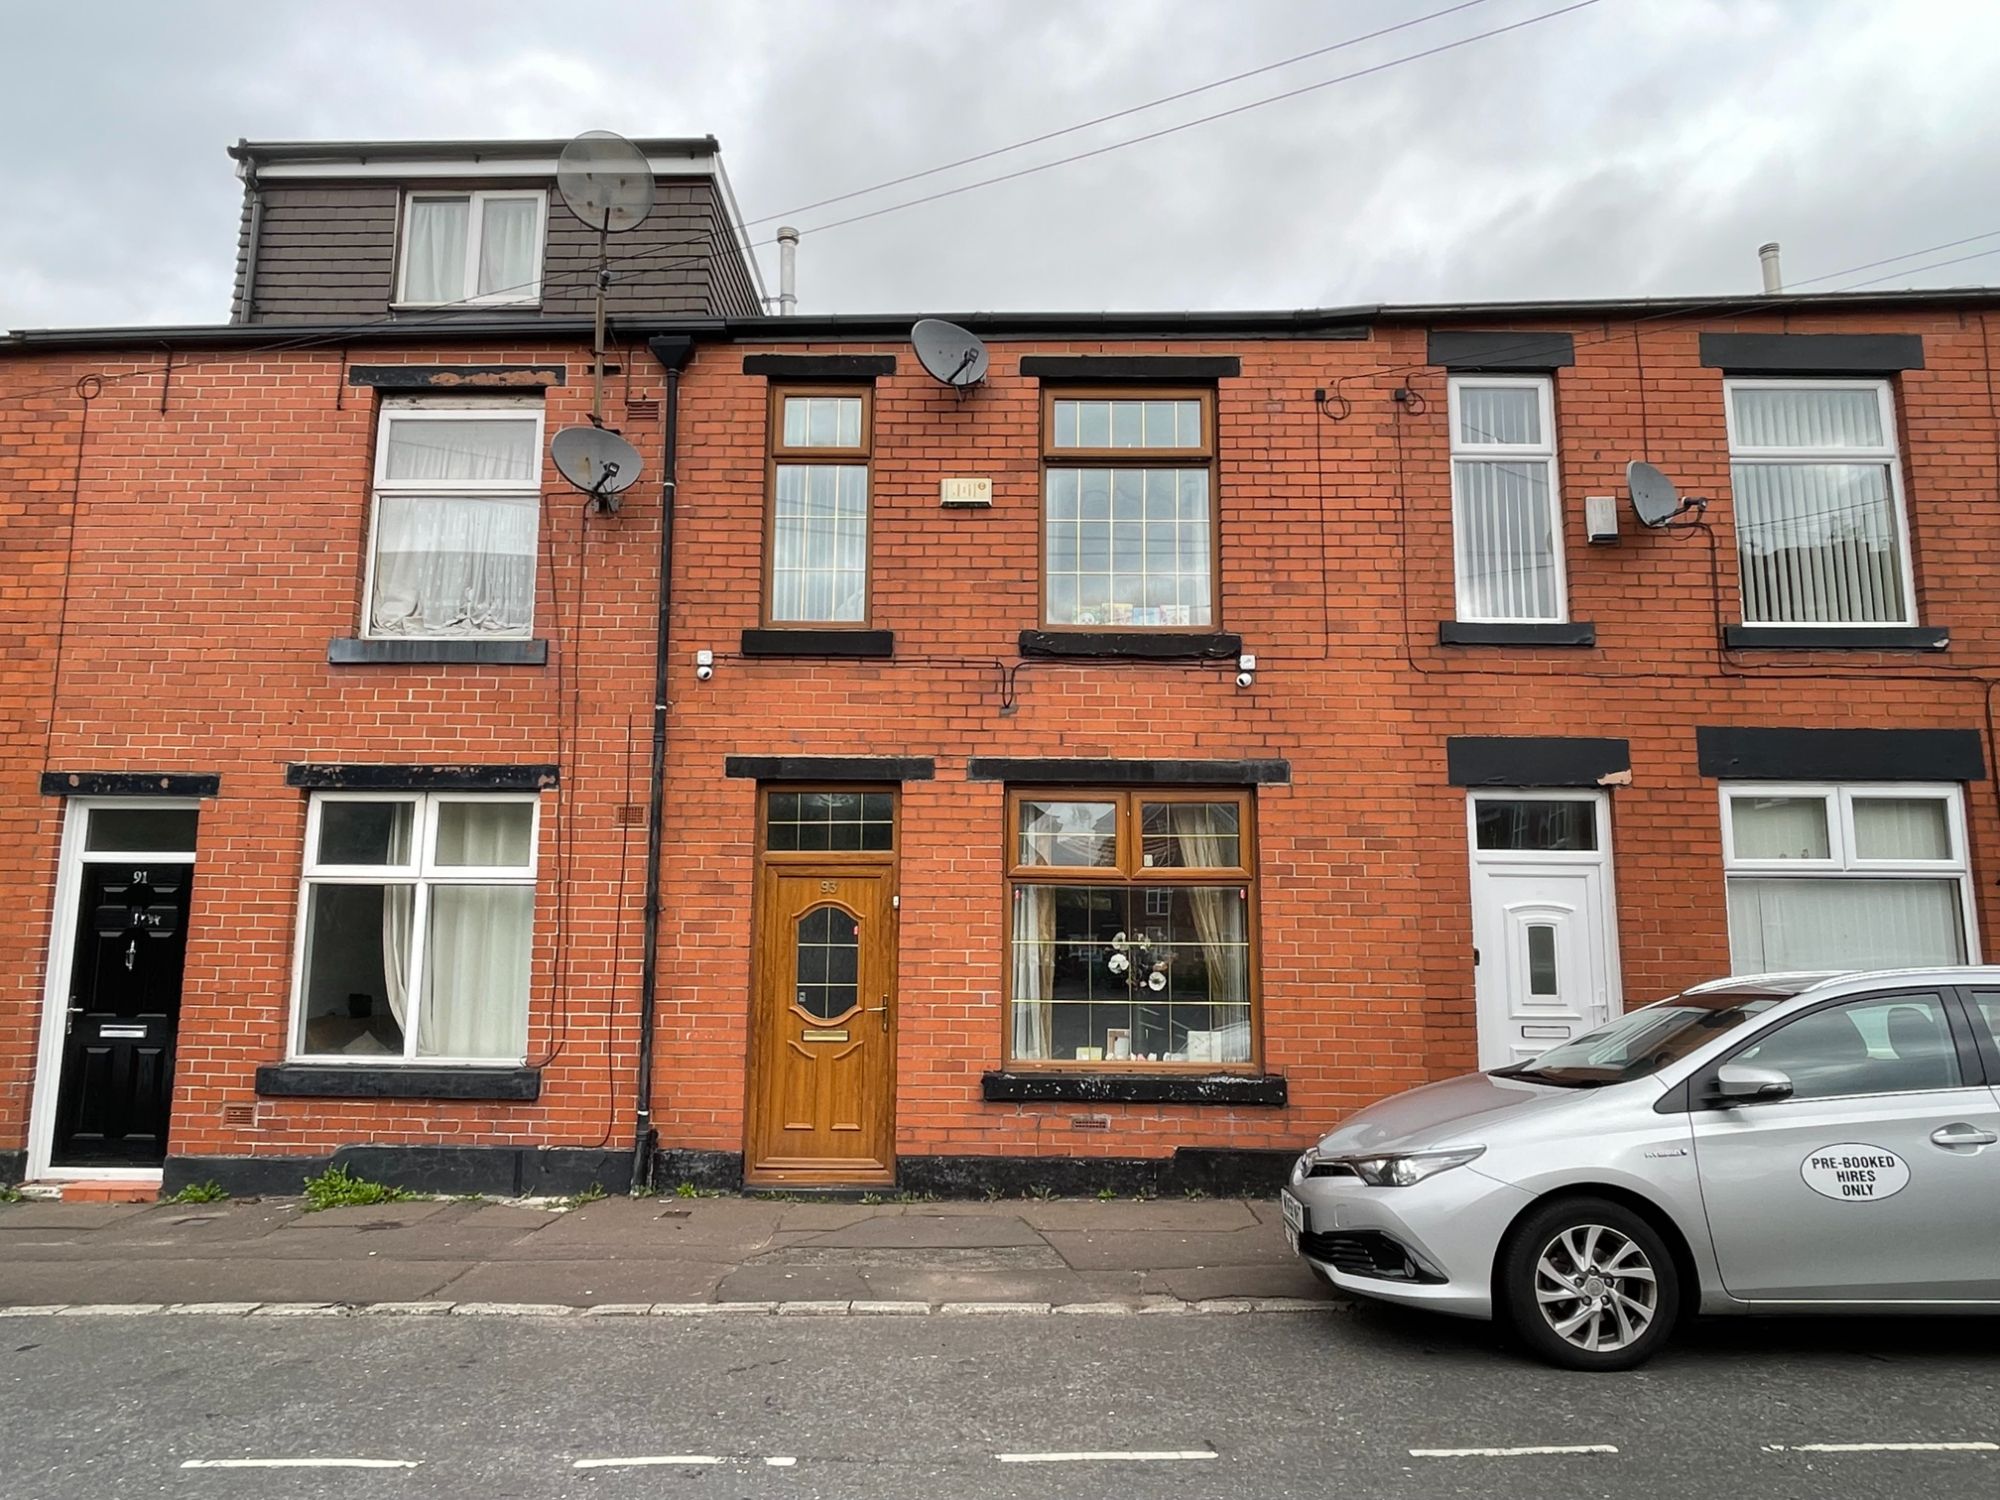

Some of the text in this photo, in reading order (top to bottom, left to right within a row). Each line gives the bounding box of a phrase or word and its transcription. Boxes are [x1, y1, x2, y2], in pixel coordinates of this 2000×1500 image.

[132, 871, 148, 884] 91
[820, 880, 838, 894] 93
[1811, 1156, 1895, 1169] PRE-BOOKED
[1836, 1170, 1876, 1183] HIRES
[1842, 1184, 1874, 1196] ONLY
